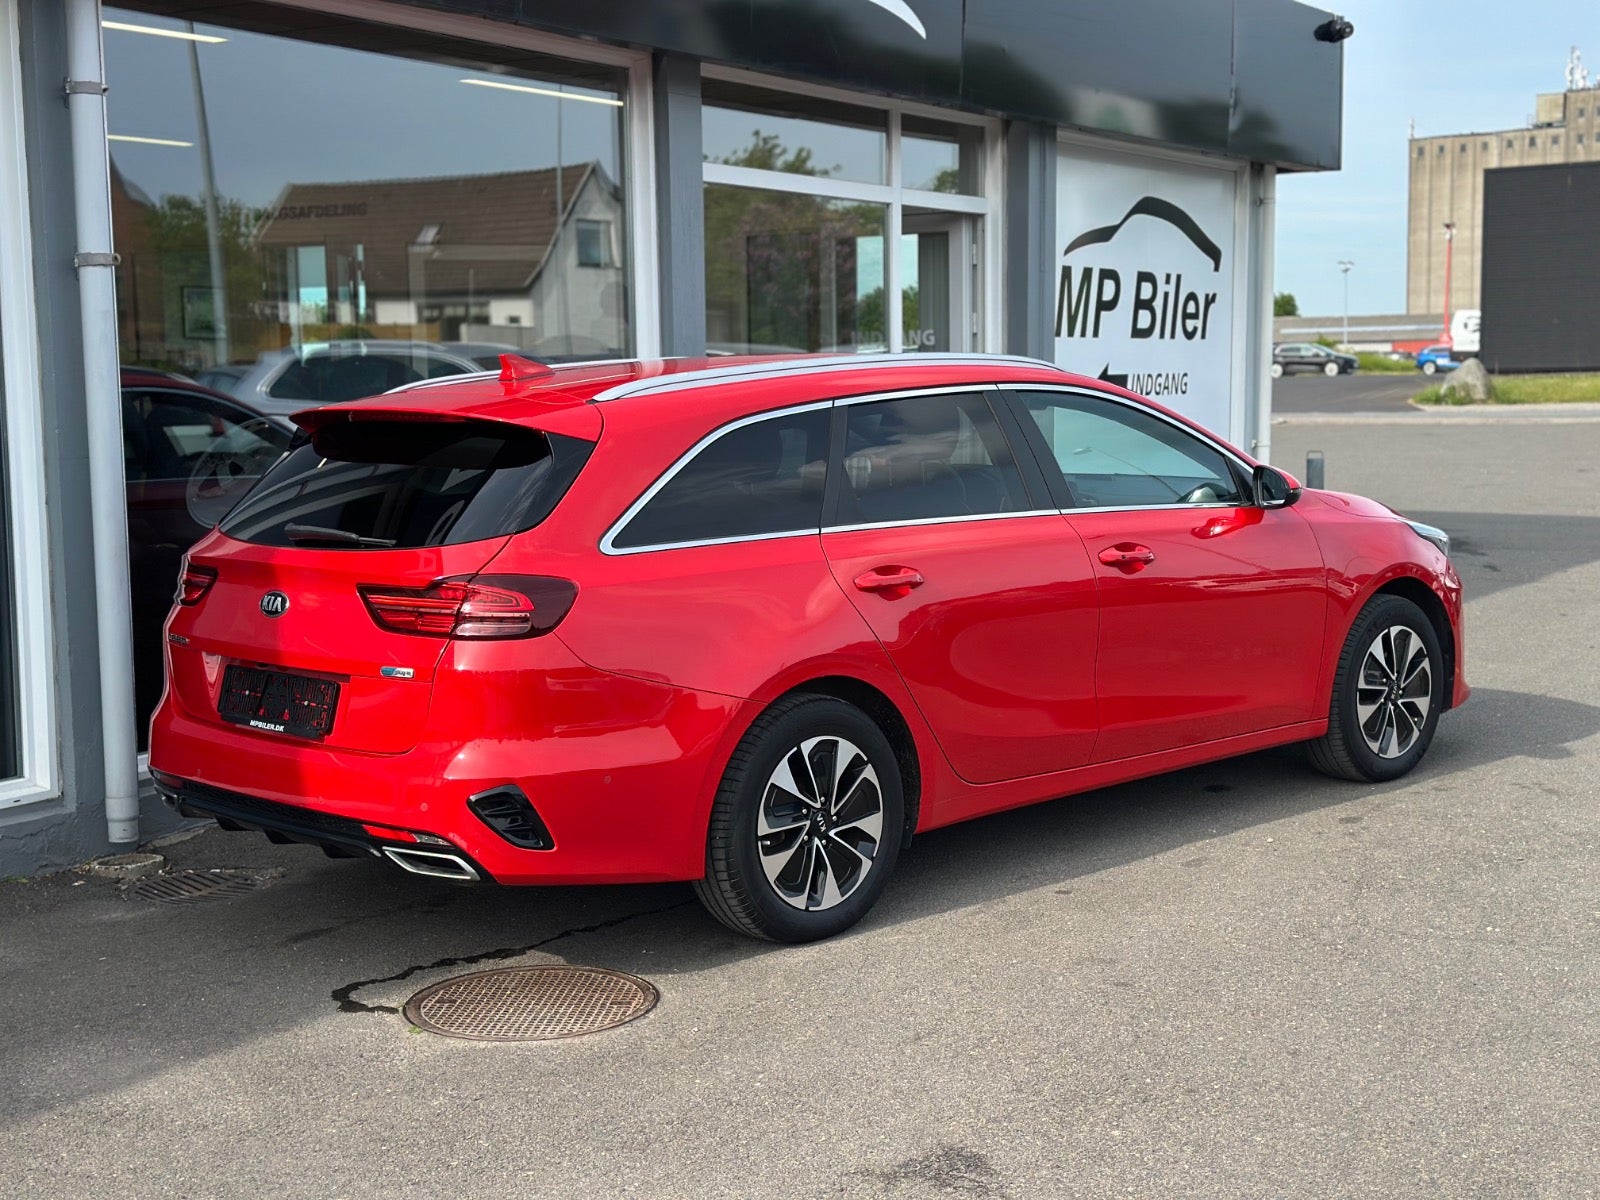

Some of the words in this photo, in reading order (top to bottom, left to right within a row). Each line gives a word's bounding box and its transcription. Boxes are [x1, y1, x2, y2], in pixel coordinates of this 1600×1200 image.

[1055, 265, 1121, 338] MP
[1130, 270, 1217, 341] Biler
[1131, 372, 1188, 396] INDGANG
[261, 595, 282, 612] KIA
[249, 719, 285, 732] MPBILER.DK
[817, 813, 827, 832] KIA
